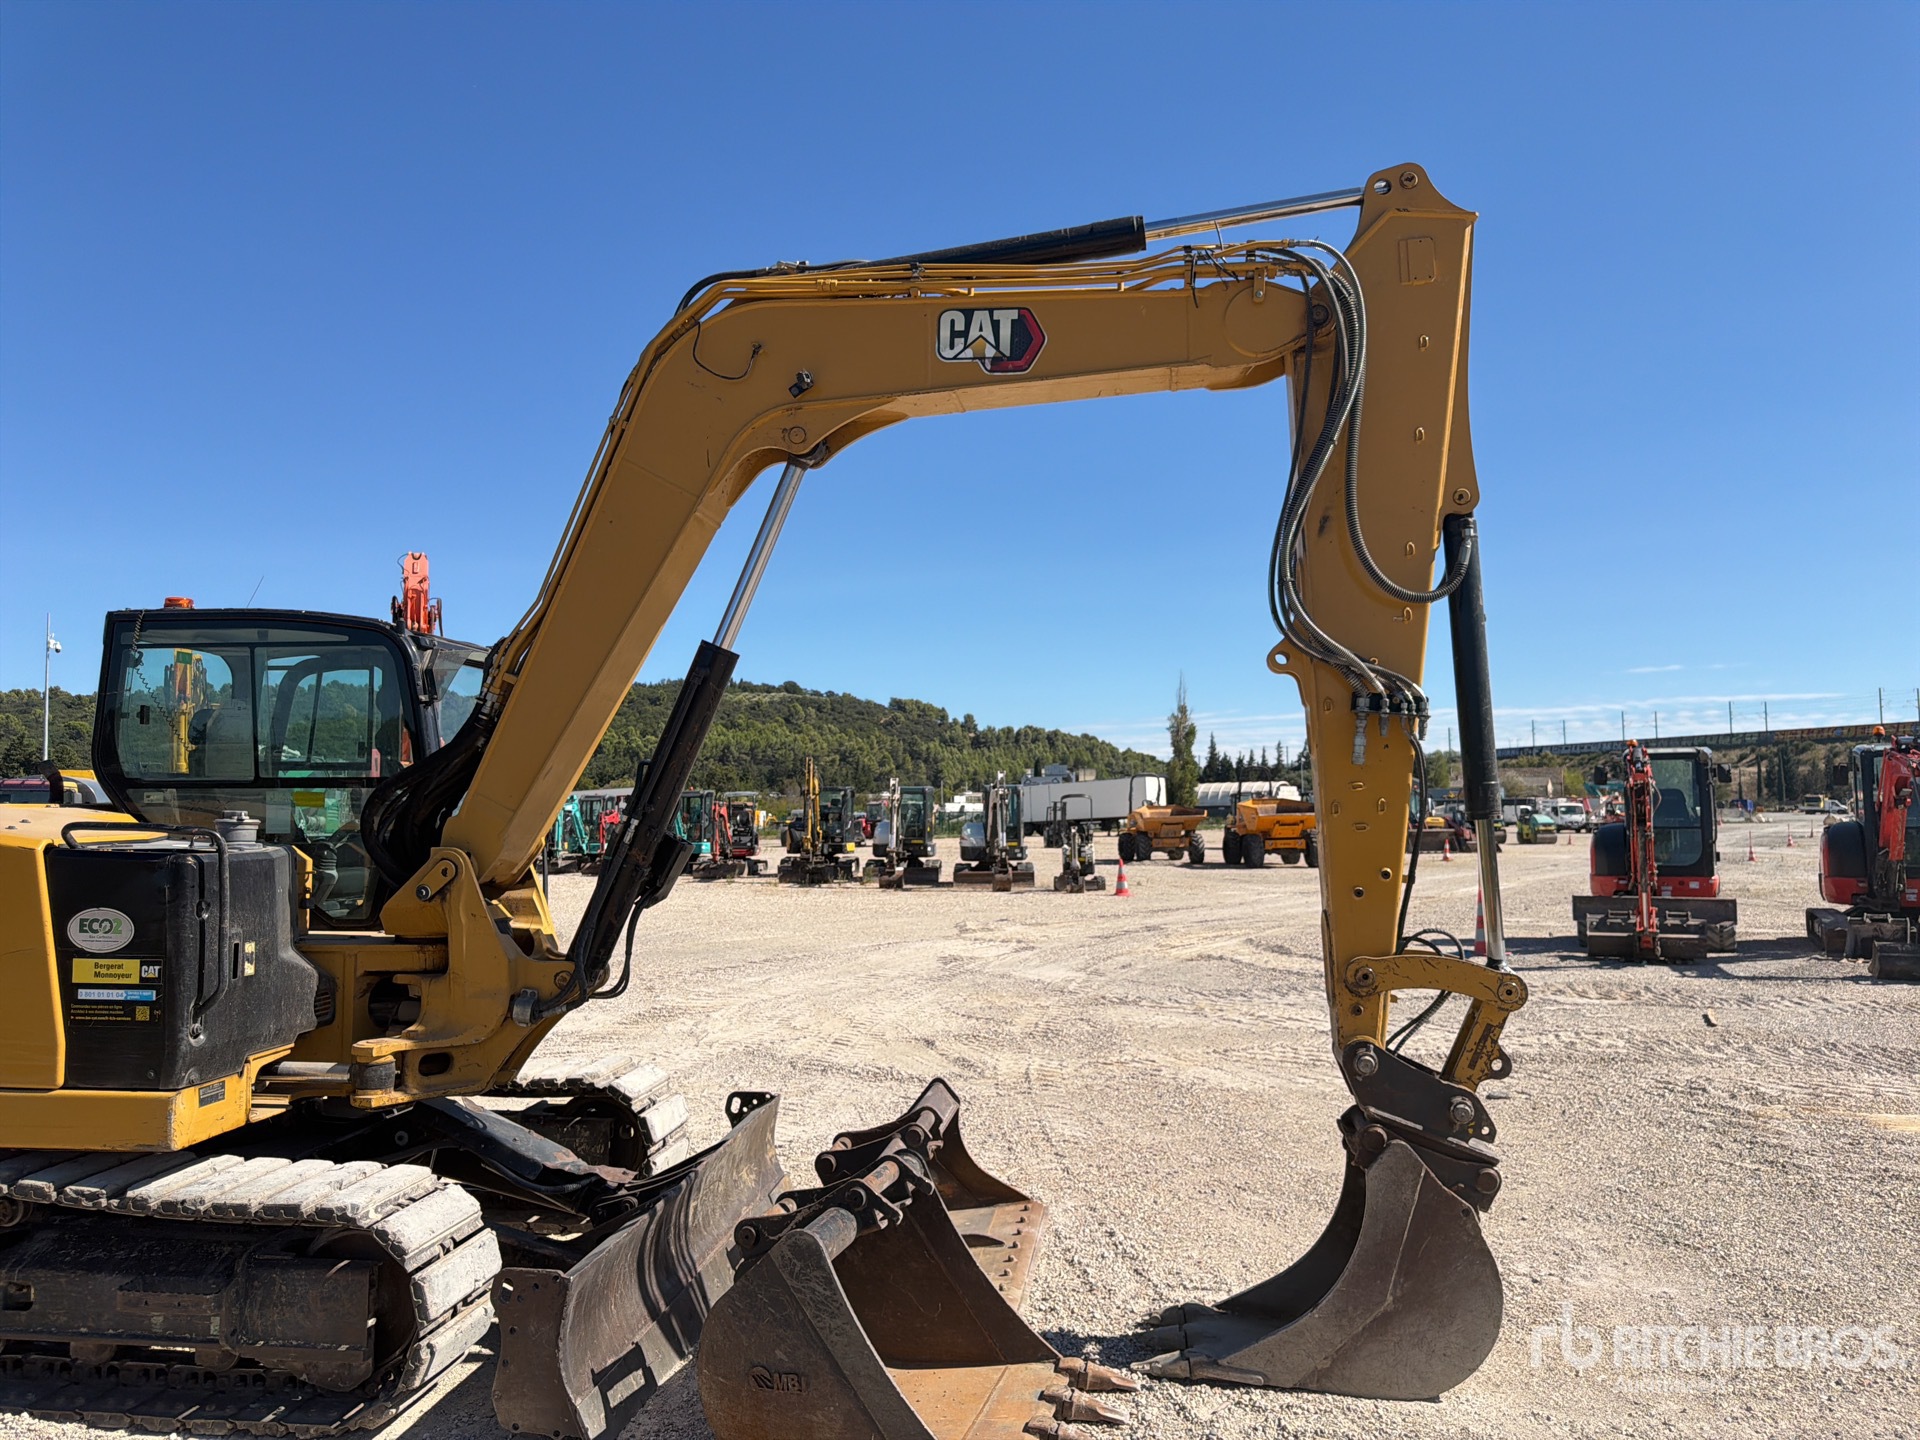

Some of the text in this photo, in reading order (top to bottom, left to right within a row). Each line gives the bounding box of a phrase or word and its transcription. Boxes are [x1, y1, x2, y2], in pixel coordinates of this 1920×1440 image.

[940, 309, 1018, 358] CAT
[79, 917, 122, 934] ECO2
[94, 962, 124, 971] Bergerat
[141, 965, 160, 978] CAT
[93, 971, 132, 980] Monnoyeur
